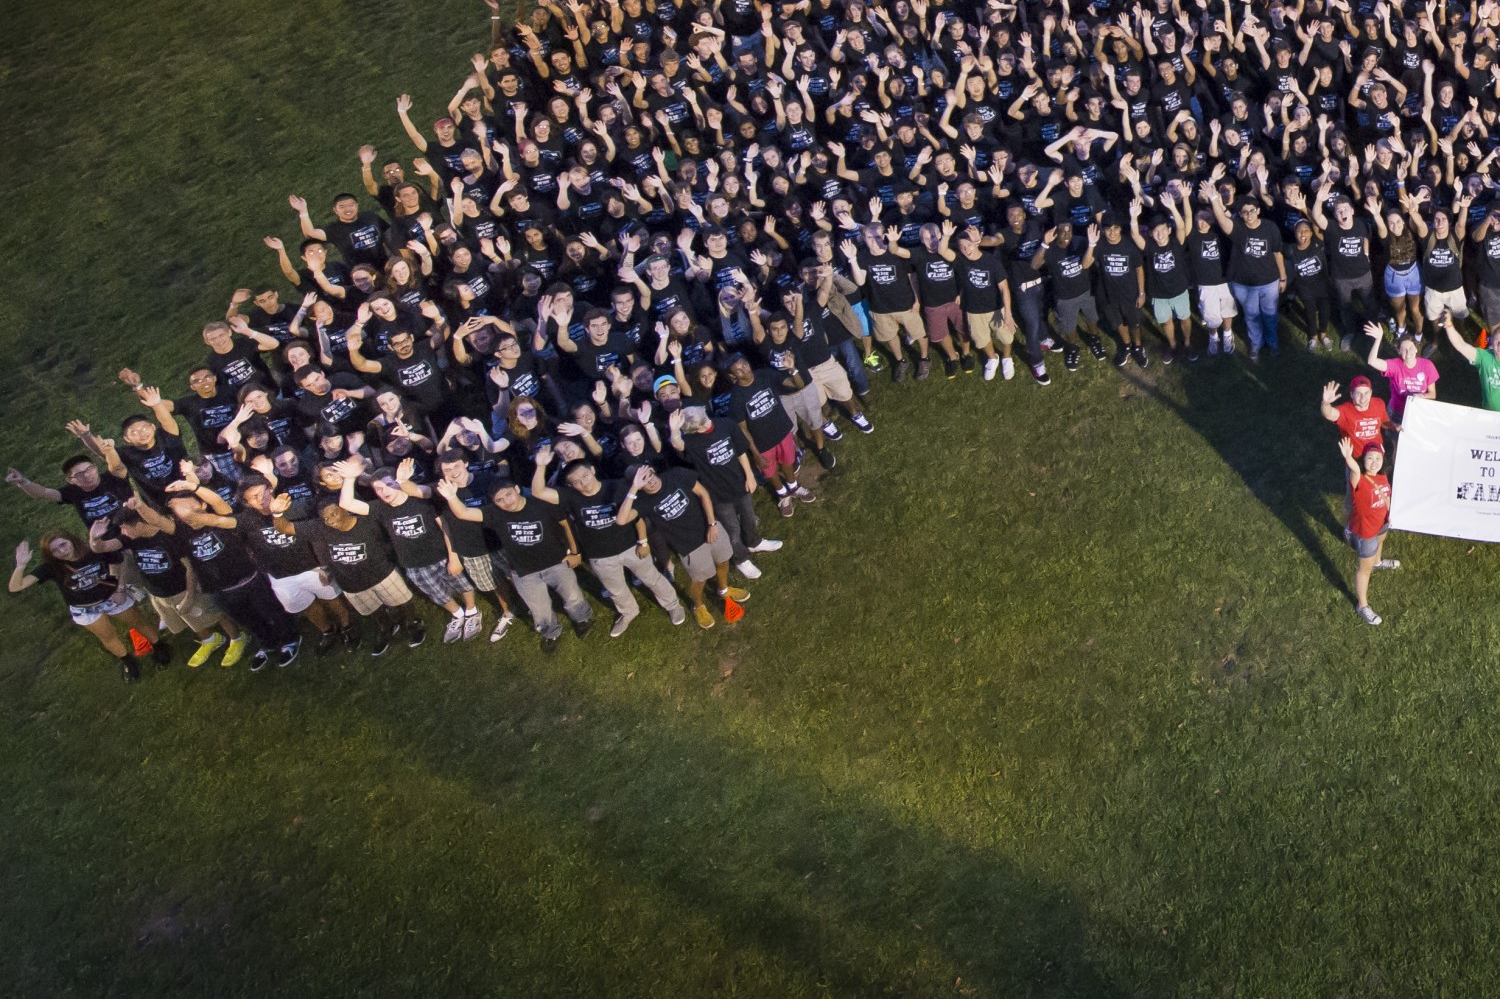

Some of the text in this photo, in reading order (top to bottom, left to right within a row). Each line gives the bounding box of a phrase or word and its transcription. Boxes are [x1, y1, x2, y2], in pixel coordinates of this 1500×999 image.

[749, 392, 770, 406] WELCOME
[707, 440, 729, 453] WELCOME
[1480, 467, 1495, 477] TO
[659, 492, 680, 510] WELCOME
[511, 534, 542, 542] FAMILY
[333, 554, 364, 562] FAMILY
